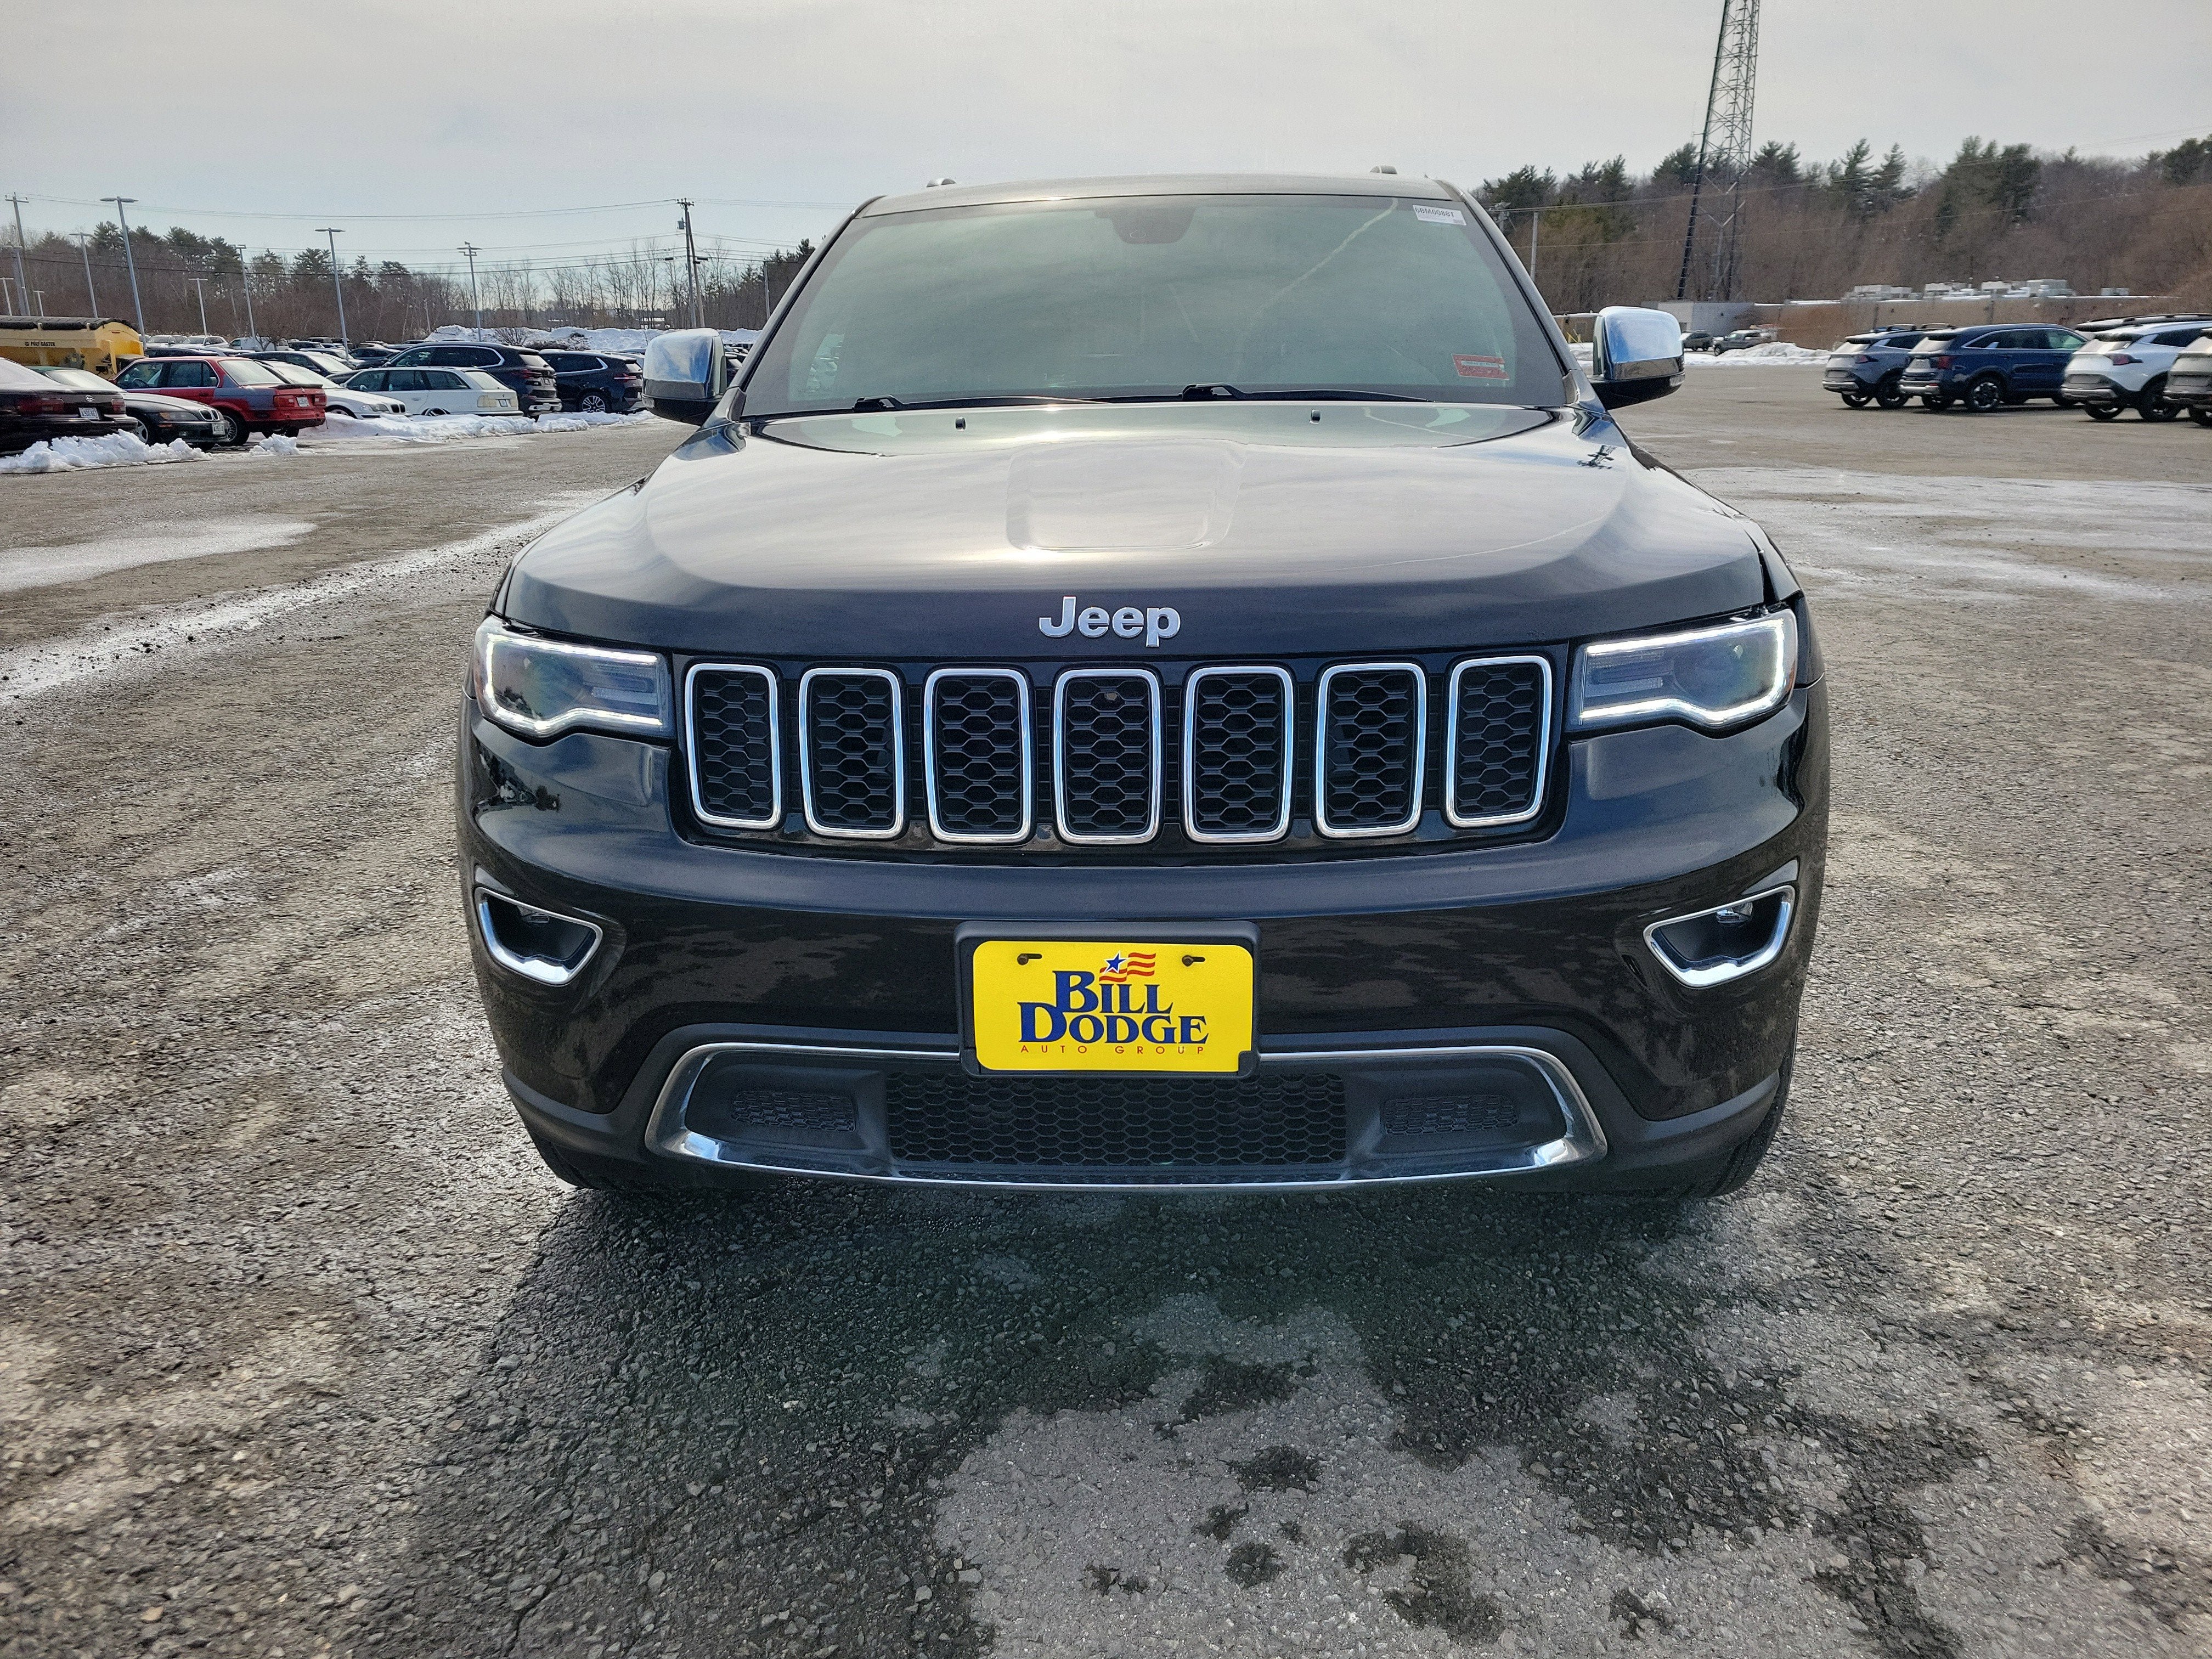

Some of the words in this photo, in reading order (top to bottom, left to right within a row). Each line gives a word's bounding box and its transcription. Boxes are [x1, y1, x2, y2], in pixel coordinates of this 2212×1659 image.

[1039, 596, 1181, 647] Jeep
[1020, 1045, 1087, 1054] AUTO
[1114, 1046, 1204, 1055] GROUP
